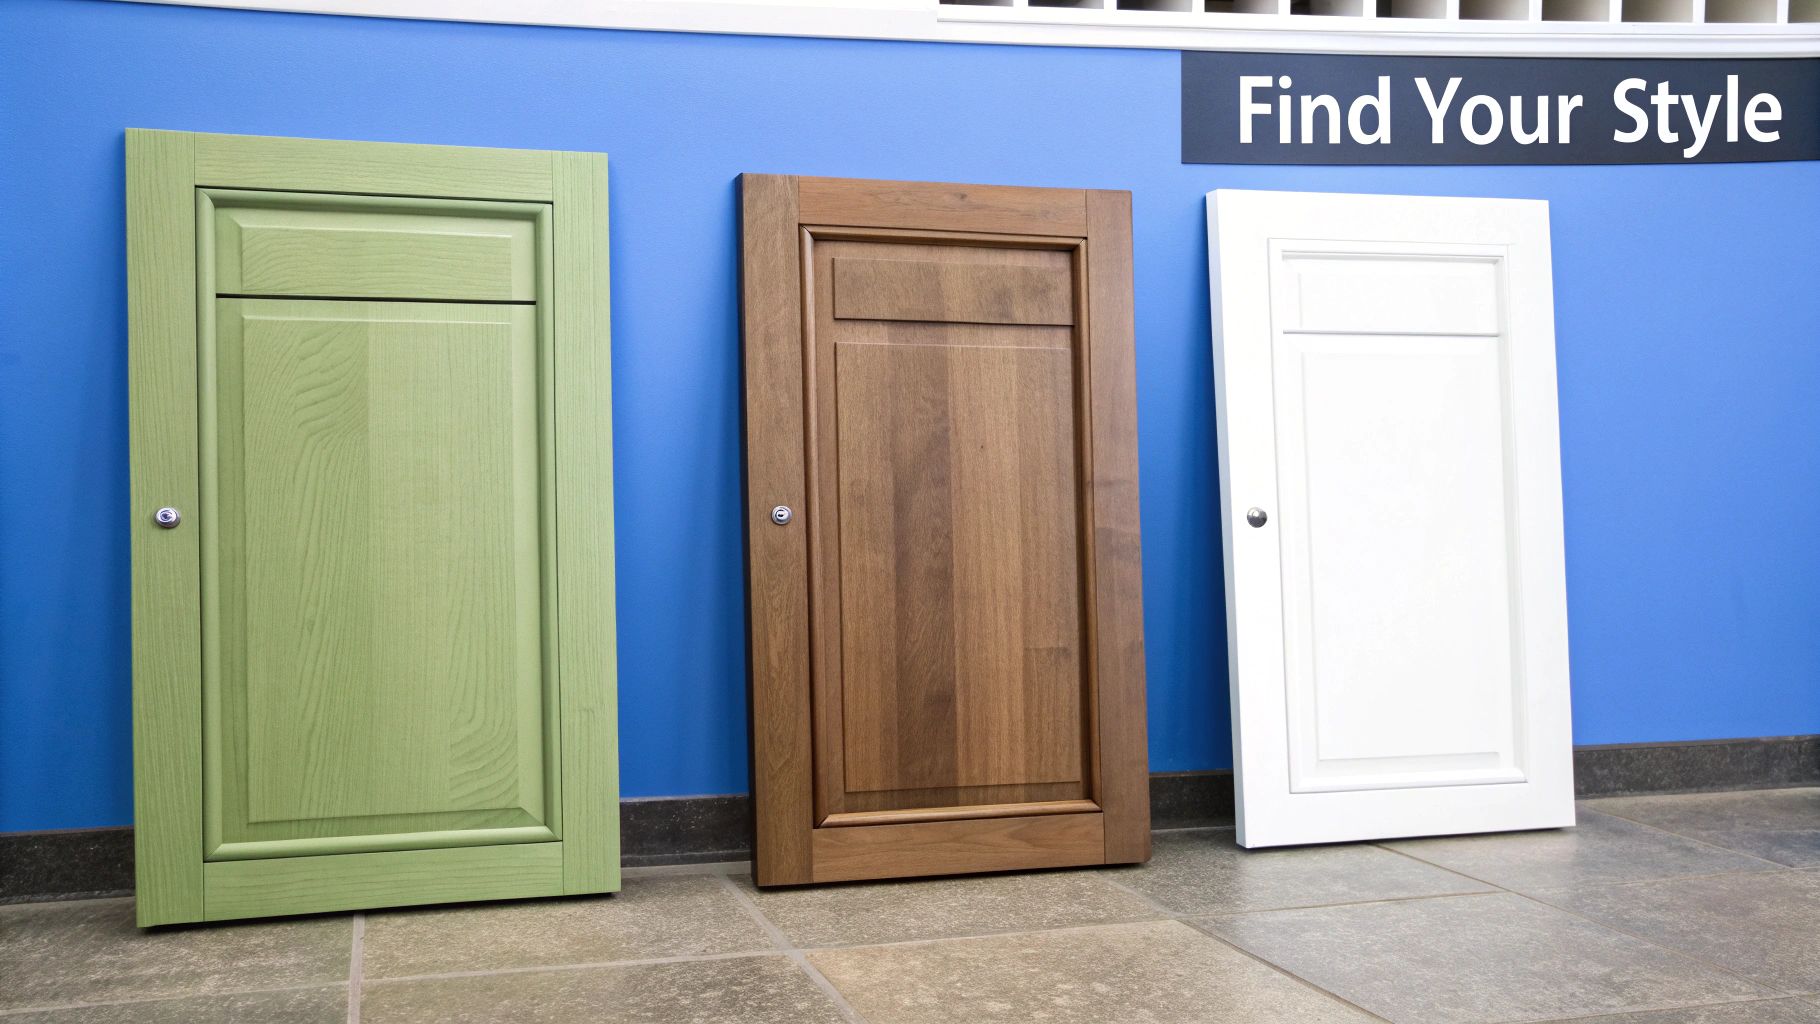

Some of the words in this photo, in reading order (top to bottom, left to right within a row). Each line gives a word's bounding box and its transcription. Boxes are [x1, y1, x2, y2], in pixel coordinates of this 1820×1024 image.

[1239, 75, 1392, 145] Find
[1414, 76, 1584, 145] Your
[1613, 74, 1783, 159] Style
